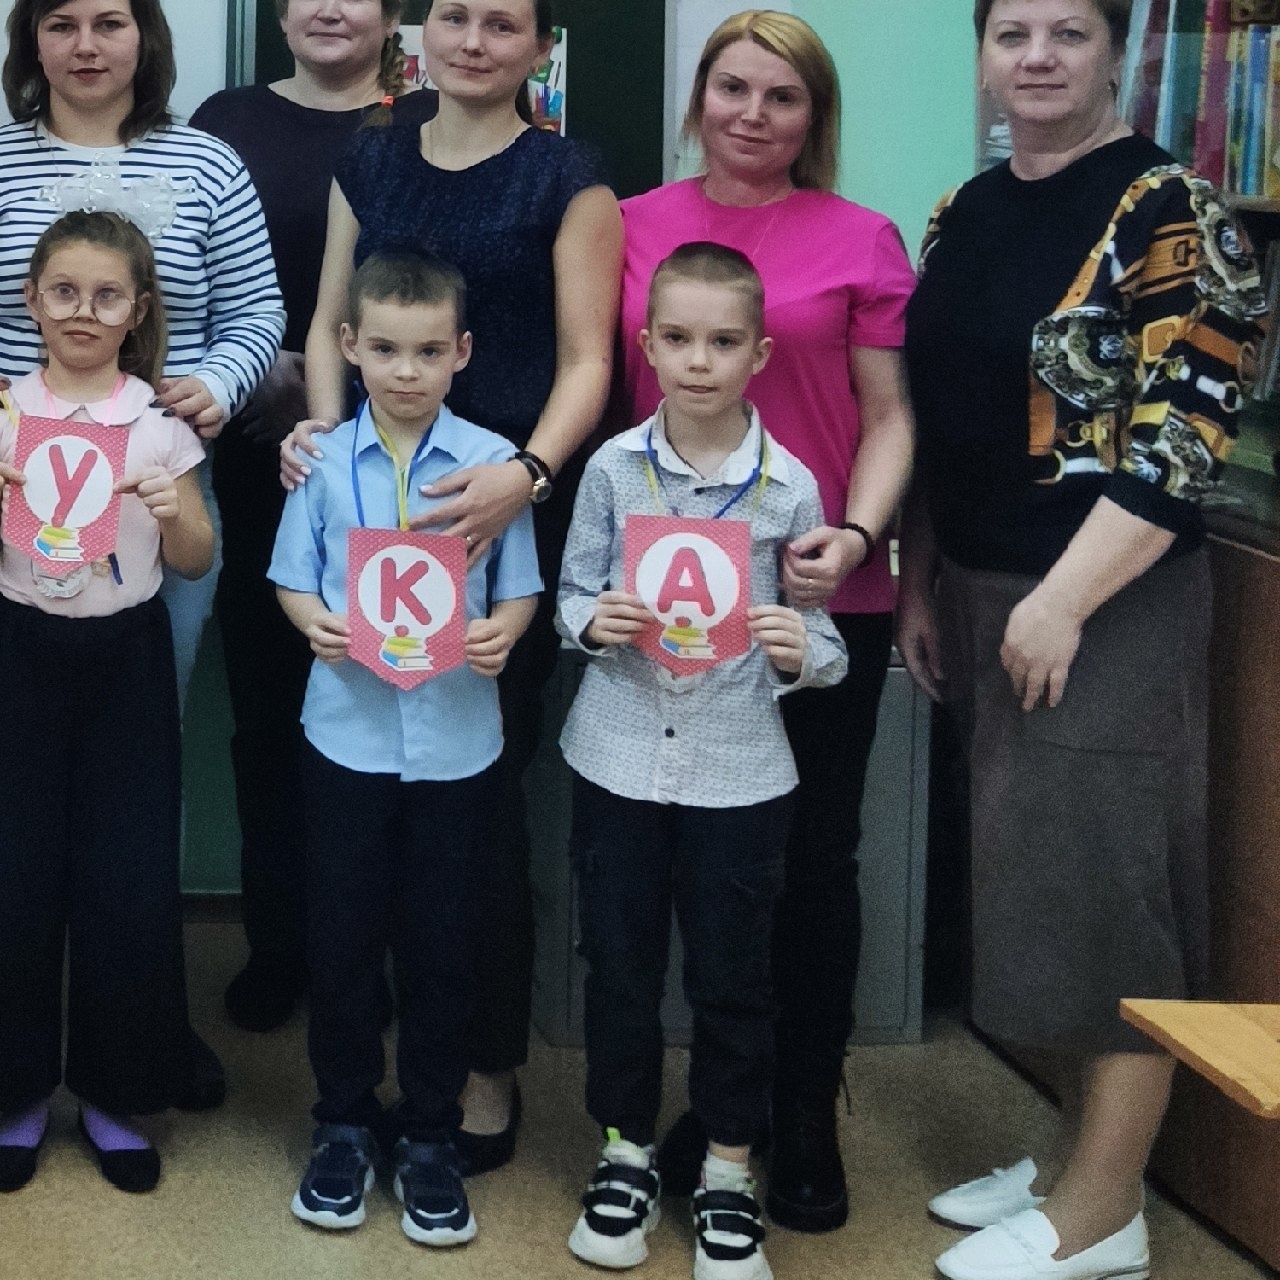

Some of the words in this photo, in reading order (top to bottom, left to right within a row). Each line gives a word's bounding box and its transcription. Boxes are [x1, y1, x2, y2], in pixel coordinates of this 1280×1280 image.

[48, 443, 98, 527] У
[380, 556, 430, 626] К
[656, 546, 715, 618] А
